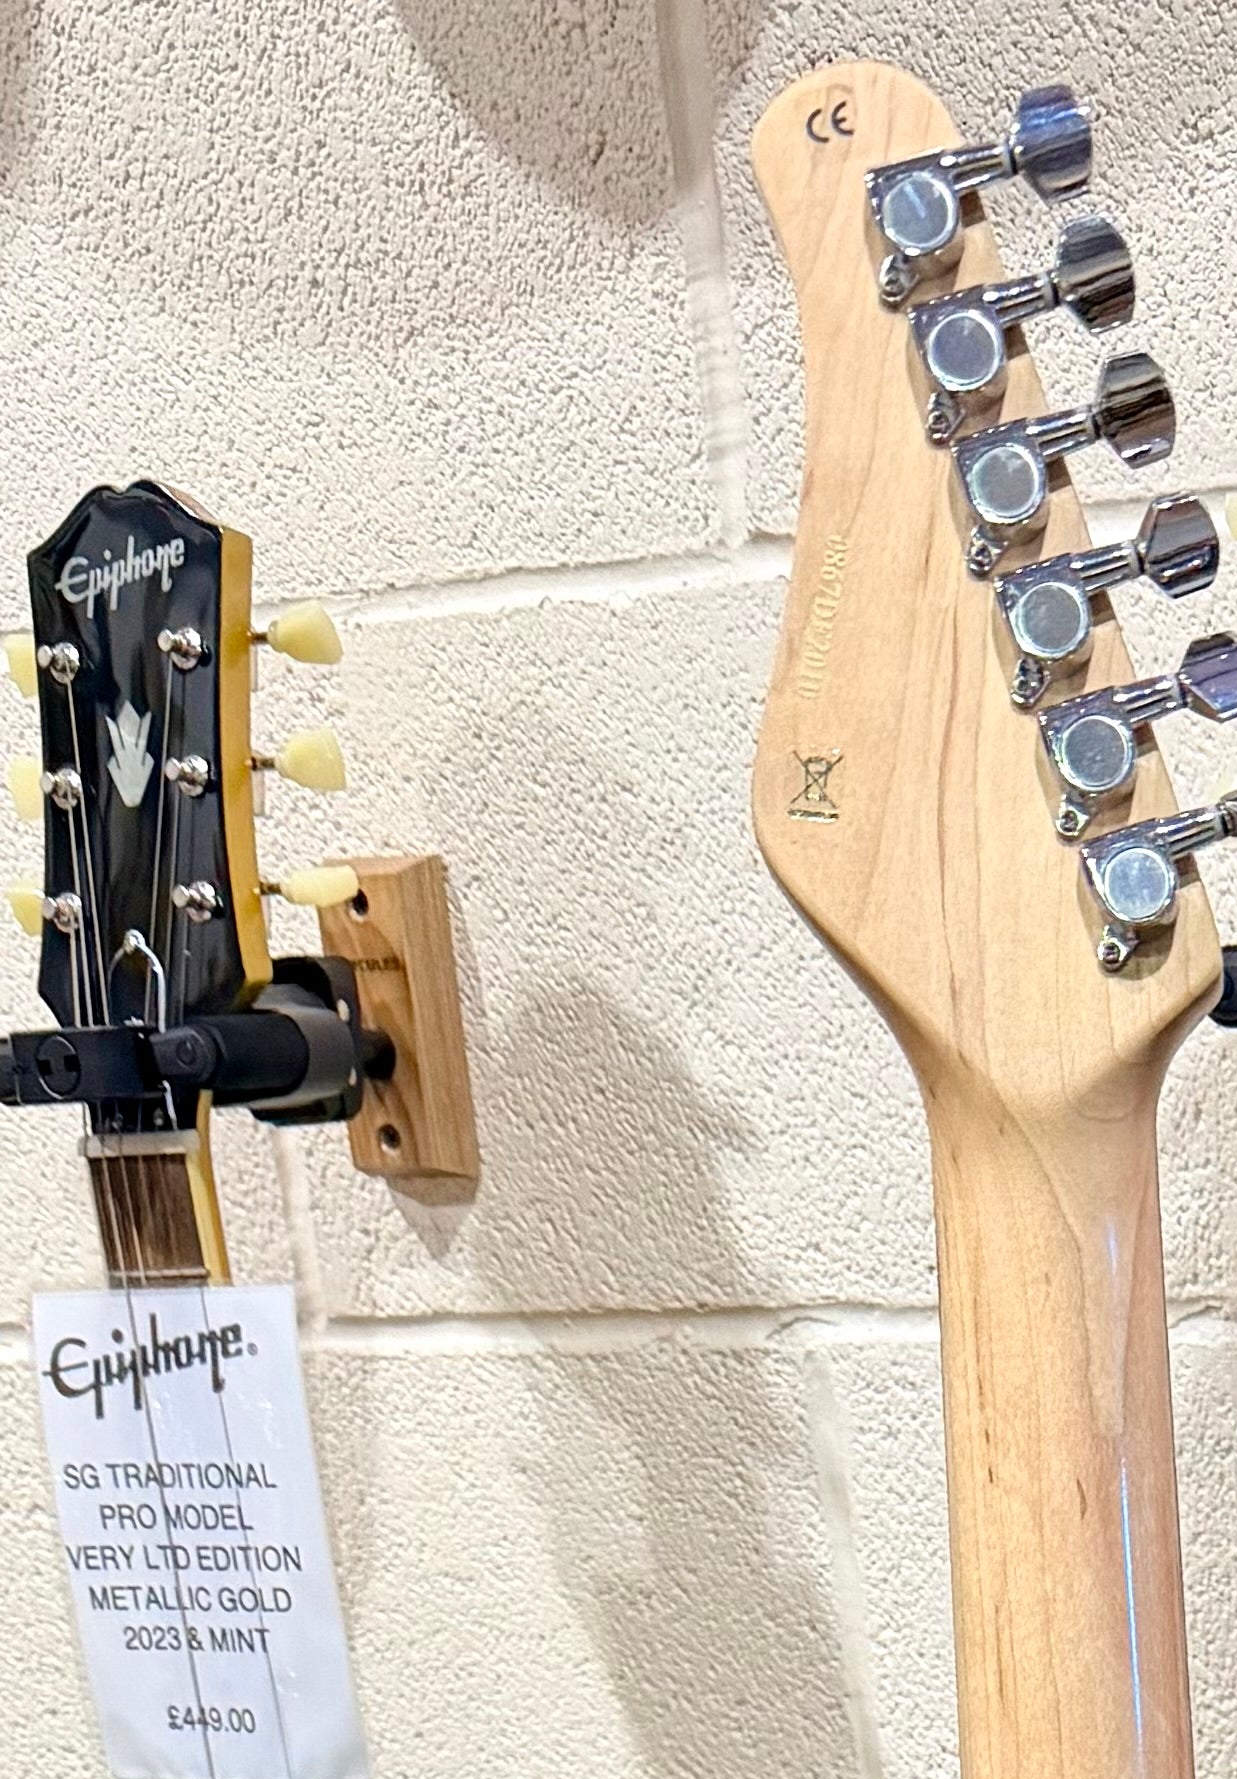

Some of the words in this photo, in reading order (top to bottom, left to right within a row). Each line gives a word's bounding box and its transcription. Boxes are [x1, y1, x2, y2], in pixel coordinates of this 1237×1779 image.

[54, 535, 185, 619] Epiphone
[63, 1462, 100, 1491] SG
[105, 1462, 278, 1491] TRADITIONAL
[99, 1503, 157, 1531] PRO
[163, 1503, 254, 1532] MODEL
[66, 1545, 136, 1572] VERY
[143, 1545, 191, 1572] LTD
[199, 1545, 302, 1573] EDITION
[89, 1586, 212, 1613] METALLIC
[219, 1586, 292, 1613] GOLD
[124, 1626, 183, 1652] 2023
[187, 1627, 204, 1653] &
[210, 1627, 271, 1654] MINT
[167, 1705, 257, 1735] £449.00
